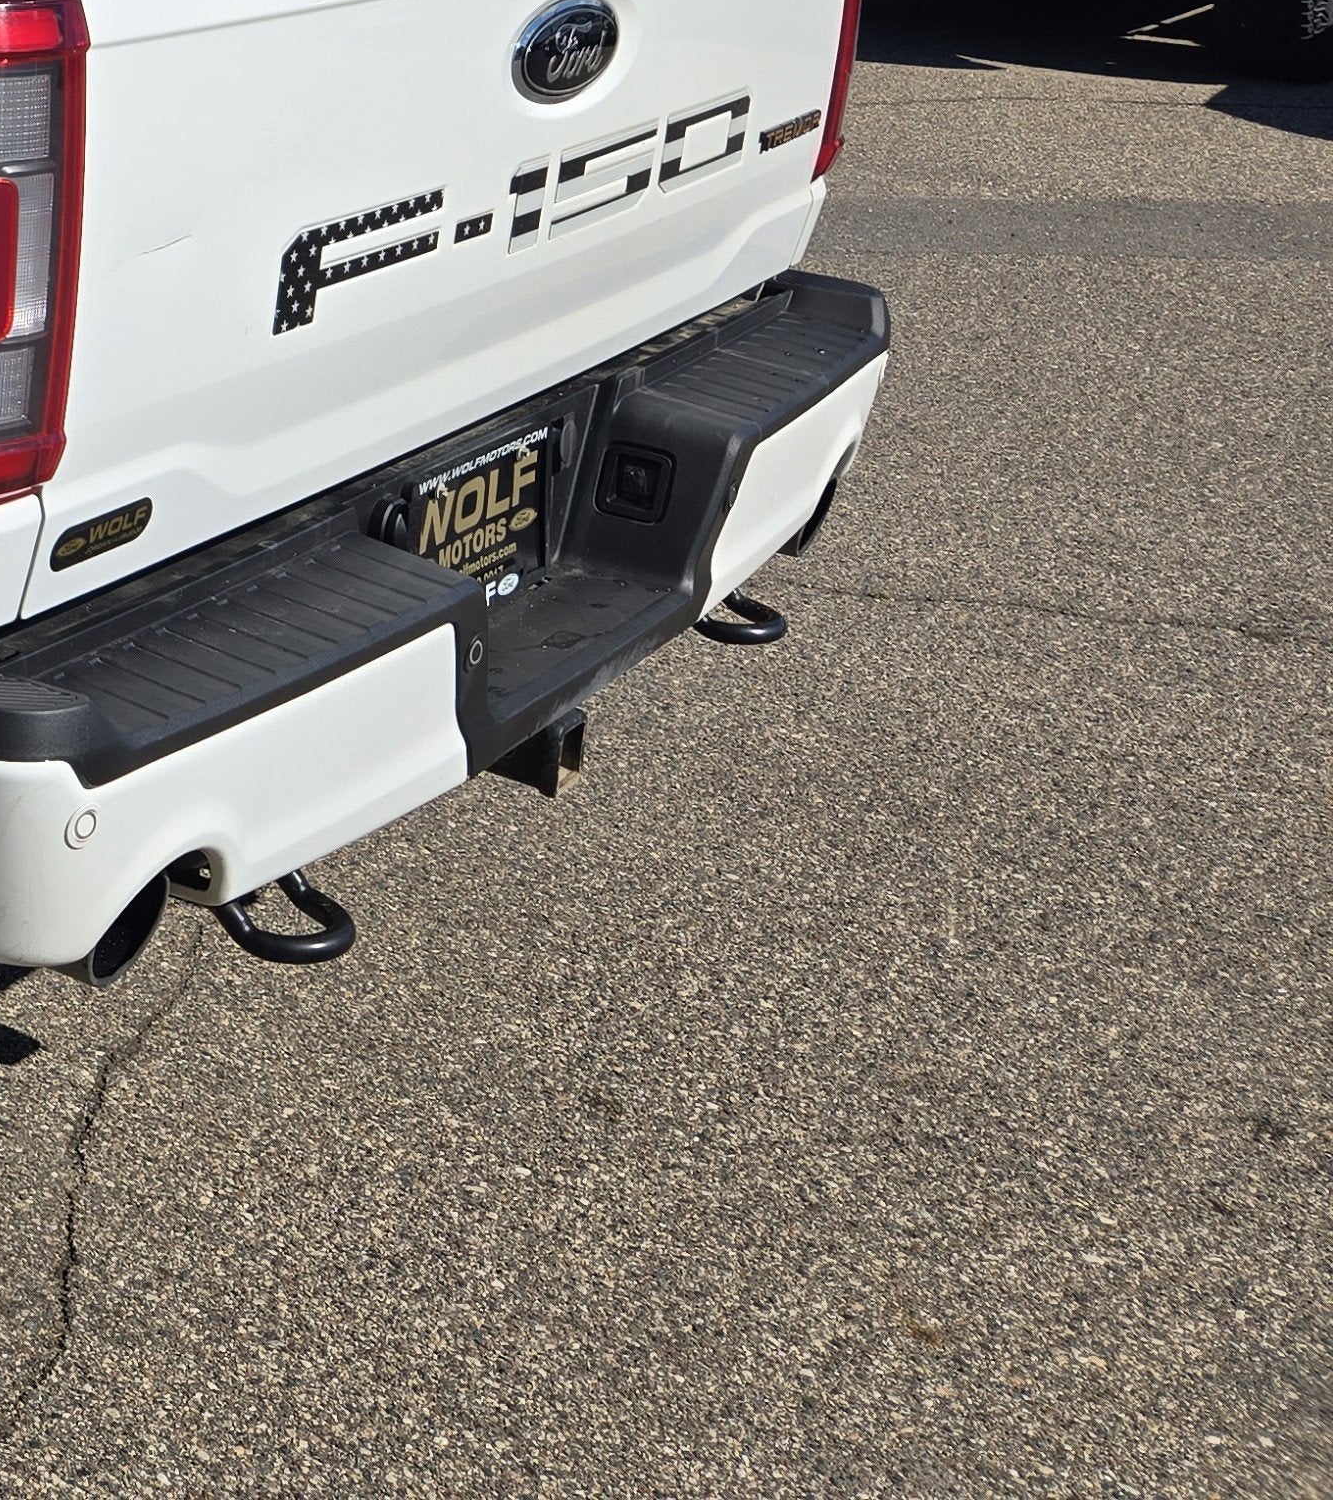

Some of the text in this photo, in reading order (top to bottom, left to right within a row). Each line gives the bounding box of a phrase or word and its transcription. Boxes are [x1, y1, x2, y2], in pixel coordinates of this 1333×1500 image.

[546, 20, 607, 83] Ford
[759, 109, 821, 154] TREMOR
[272, 88, 752, 336] F-150
[89, 505, 148, 544] WOLF
[438, 517, 508, 569] MOTORS
